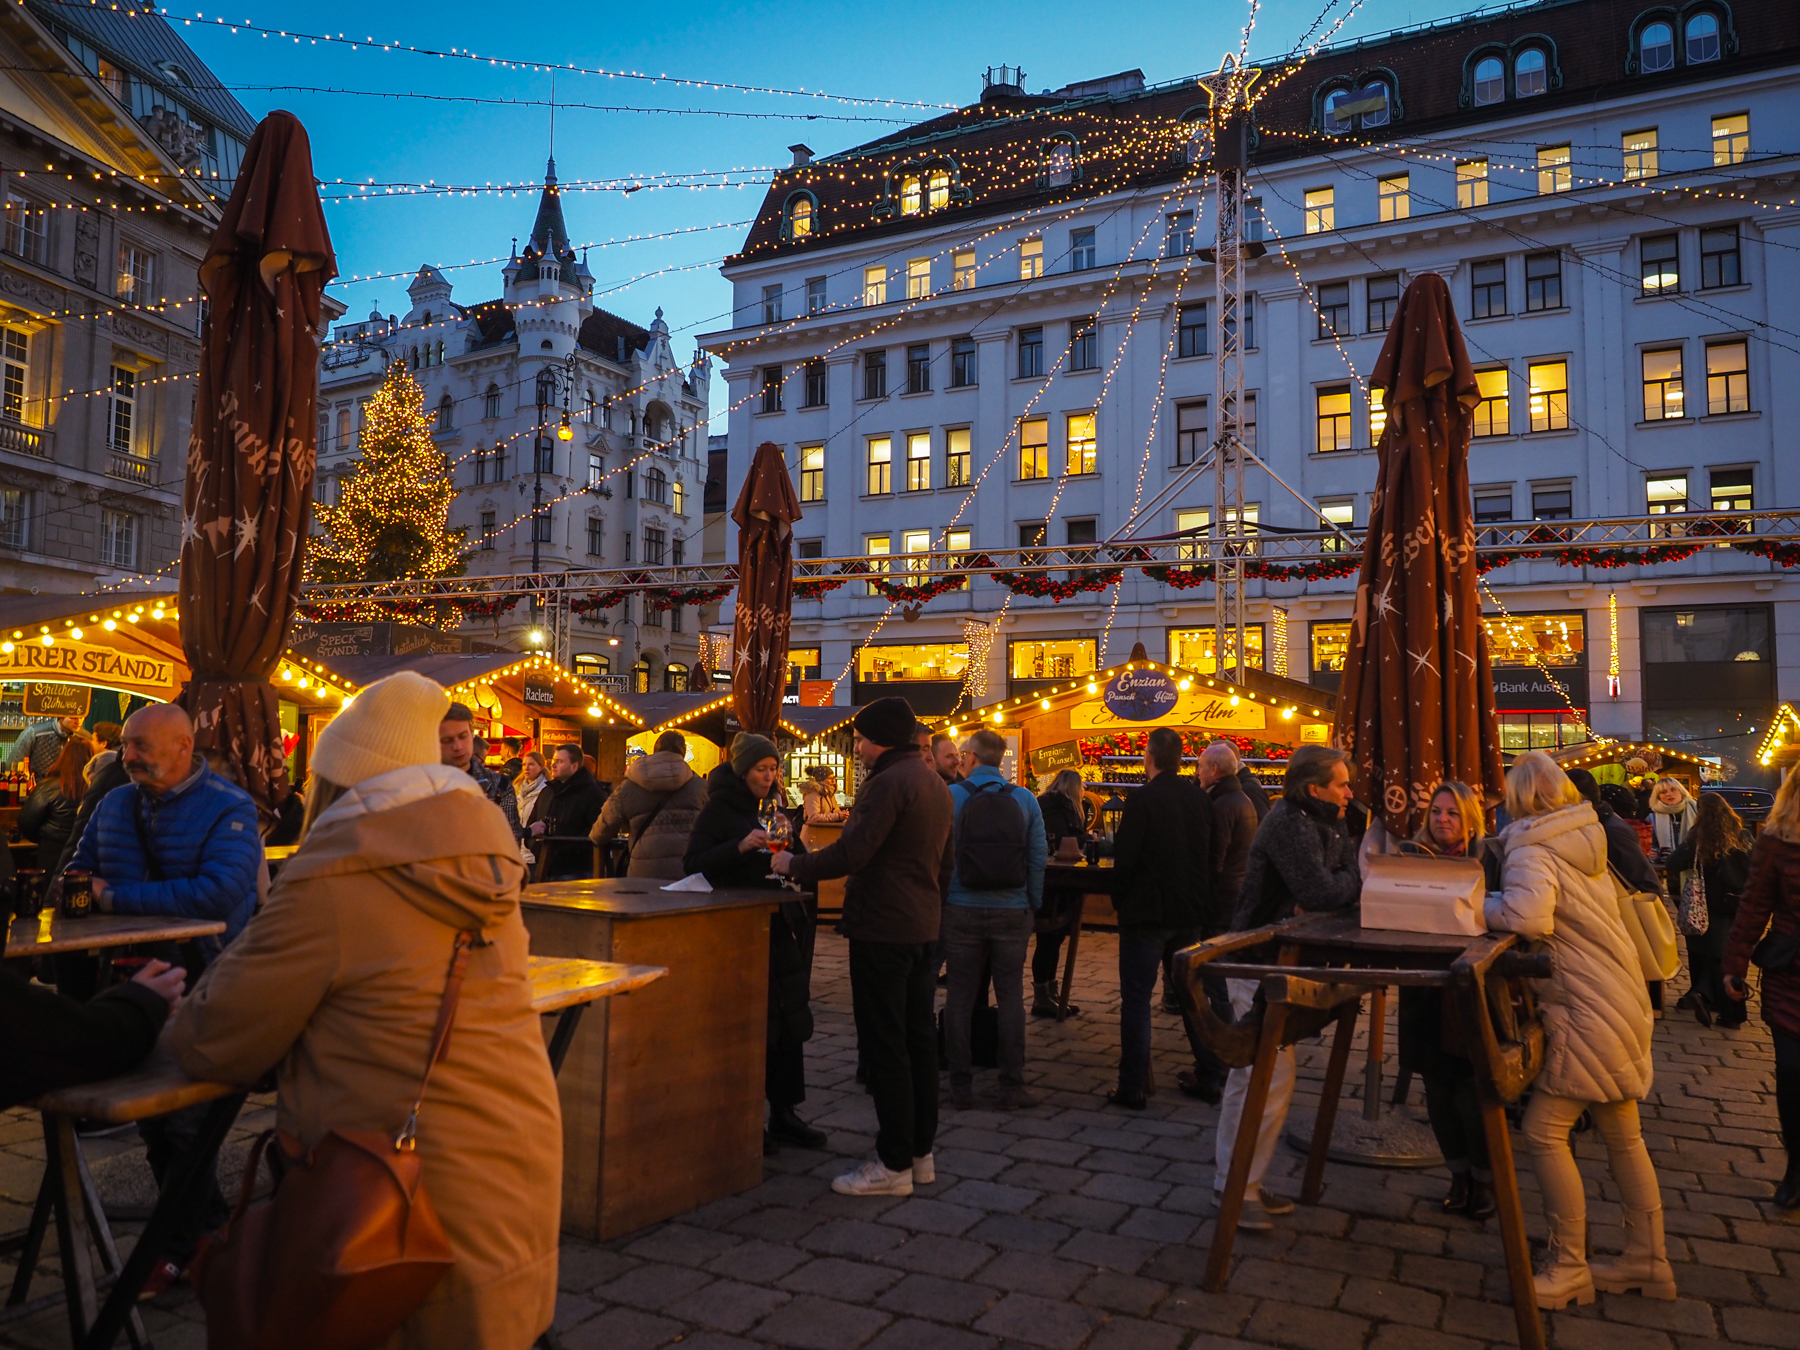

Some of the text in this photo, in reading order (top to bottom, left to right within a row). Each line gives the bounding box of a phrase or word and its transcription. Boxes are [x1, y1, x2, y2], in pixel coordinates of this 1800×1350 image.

[320, 634, 356, 646] SPECK
[317, 645, 359, 657] STANDL
[431, 641, 453, 654] SPECK
[82, 651, 168, 682] STANDL
[1117, 671, 1167, 691] Enzian
[1500, 681, 1529, 693] Bank
[525, 687, 554, 703] Raclette
[1105, 691, 1136, 703] Punsch
[1182, 700, 1238, 724] Alm
[1038, 747, 1066, 760] Enzian-
[1048, 752, 1075, 768] Punsch
